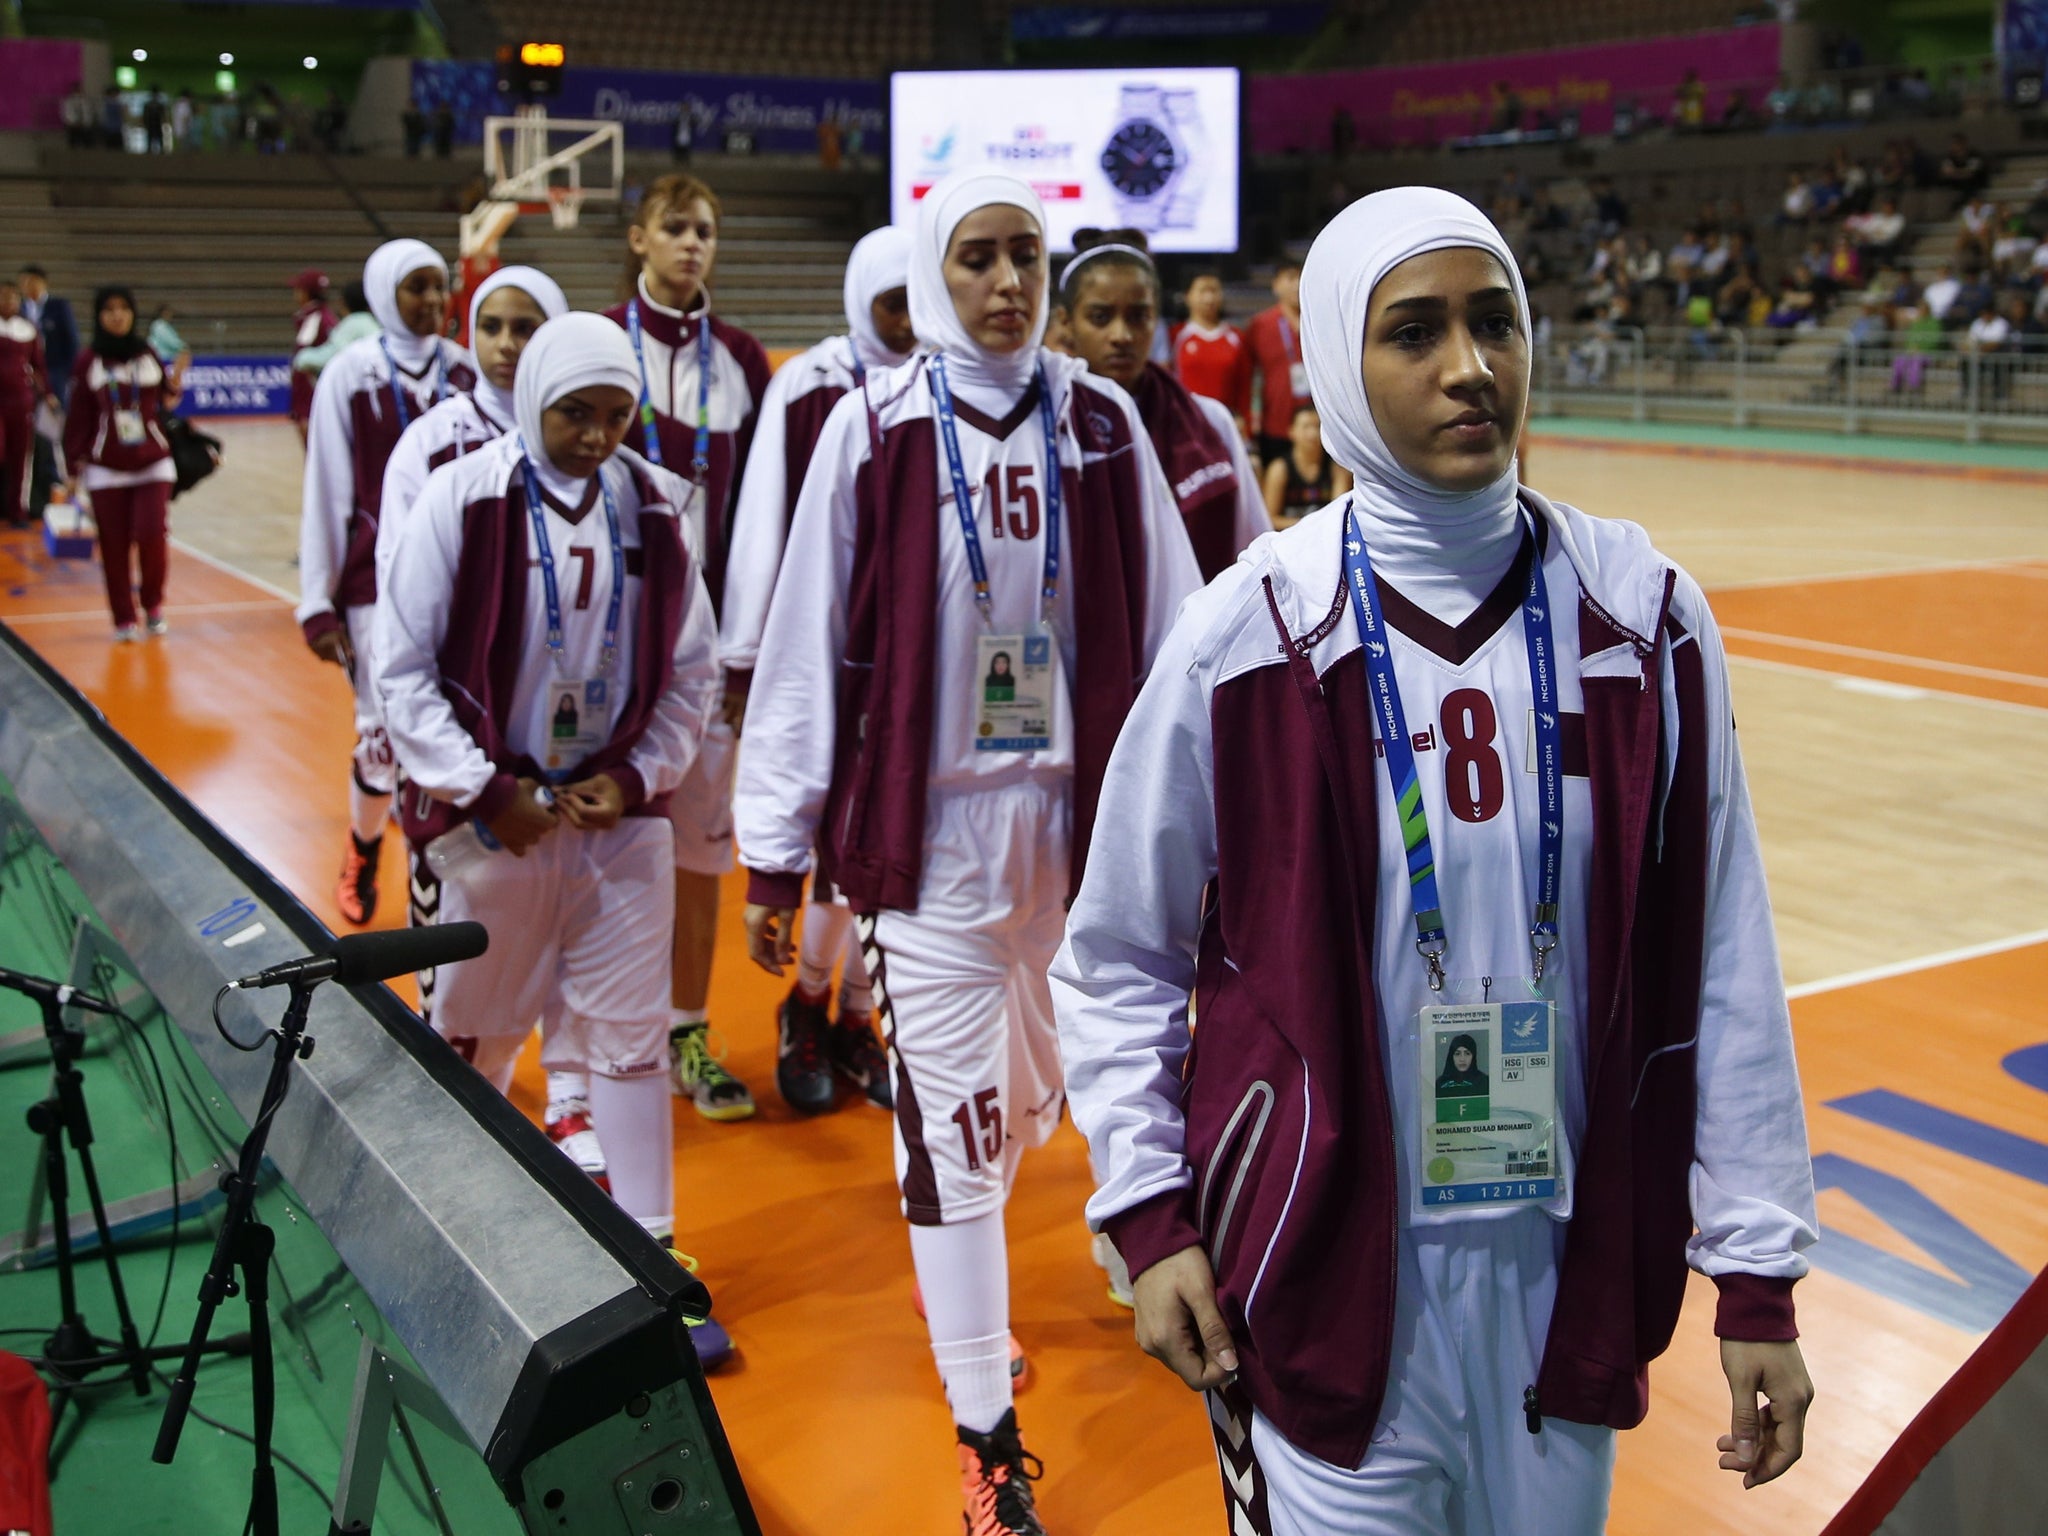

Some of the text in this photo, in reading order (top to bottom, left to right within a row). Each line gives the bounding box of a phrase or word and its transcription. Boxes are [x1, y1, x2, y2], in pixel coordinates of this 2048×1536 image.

[985, 464, 1040, 540] 15
[569, 546, 595, 610] 7
[1354, 567, 1376, 632] INCHEON 2014
[1585, 598, 1612, 626] BURRDA
[1535, 637, 1549, 702] INCHEON 2014
[1377, 672, 1399, 740] INCHEON 2014
[1440, 688, 1505, 823] 8
[1546, 766, 1555, 811] INCHEON
[1504, 1058, 1522, 1067] HSG
[1507, 1071, 1519, 1080] AV
[1530, 1057, 1546, 1066] SSG
[952, 1086, 1002, 1171] 15
[1435, 1123, 1533, 1135] MOHAMED SUAAD MOHAMED
[1459, 1103, 1467, 1117] F
[1439, 1189, 1456, 1201] AS
